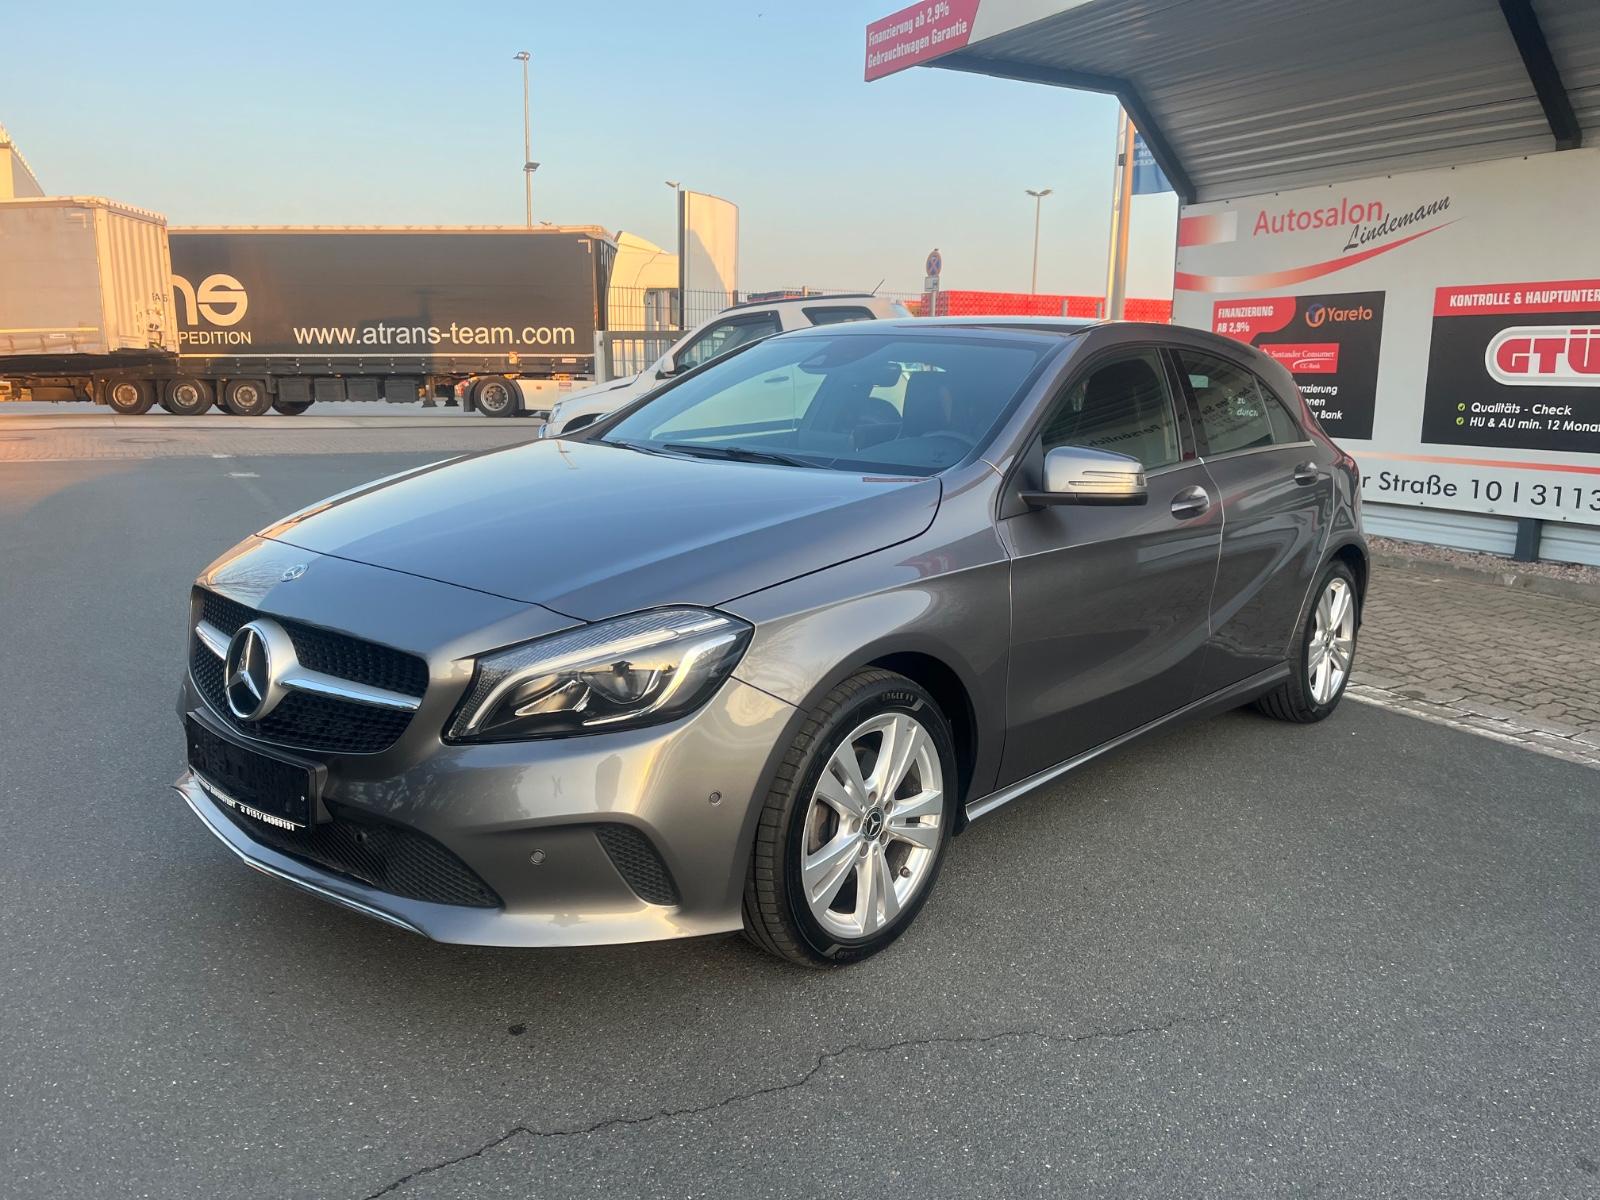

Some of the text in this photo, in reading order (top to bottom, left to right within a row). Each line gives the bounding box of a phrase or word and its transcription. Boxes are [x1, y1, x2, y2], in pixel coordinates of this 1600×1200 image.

[869, 2, 949, 46] Finanzierung ab 2,9%
[868, 19, 967, 68] Gebrauchtwagen Garantie
[1253, 198, 1383, 236] Autosalon
[1343, 196, 1450, 252] Lindemann
[1450, 293, 1510, 307] KONTROLLE
[1514, 292, 1522, 304] &
[1218, 306, 1274, 318] FINANZIERUNG
[1327, 306, 1373, 321] Yareto
[293, 321, 575, 344] www.atrans-team.com
[1217, 321, 1250, 334] AB 2,9%
[1320, 409, 1343, 420] Bank
[1471, 402, 1521, 414] Qualitäts
[1532, 404, 1572, 416] Check
[1470, 417, 1485, 428] HU
[1488, 418, 1495, 428] &
[1499, 418, 1516, 429] AU
[1518, 419, 1542, 430] min.
[1548, 419, 1560, 430] 12
[1379, 471, 1457, 497] Straße
[1471, 479, 1502, 502] 10
